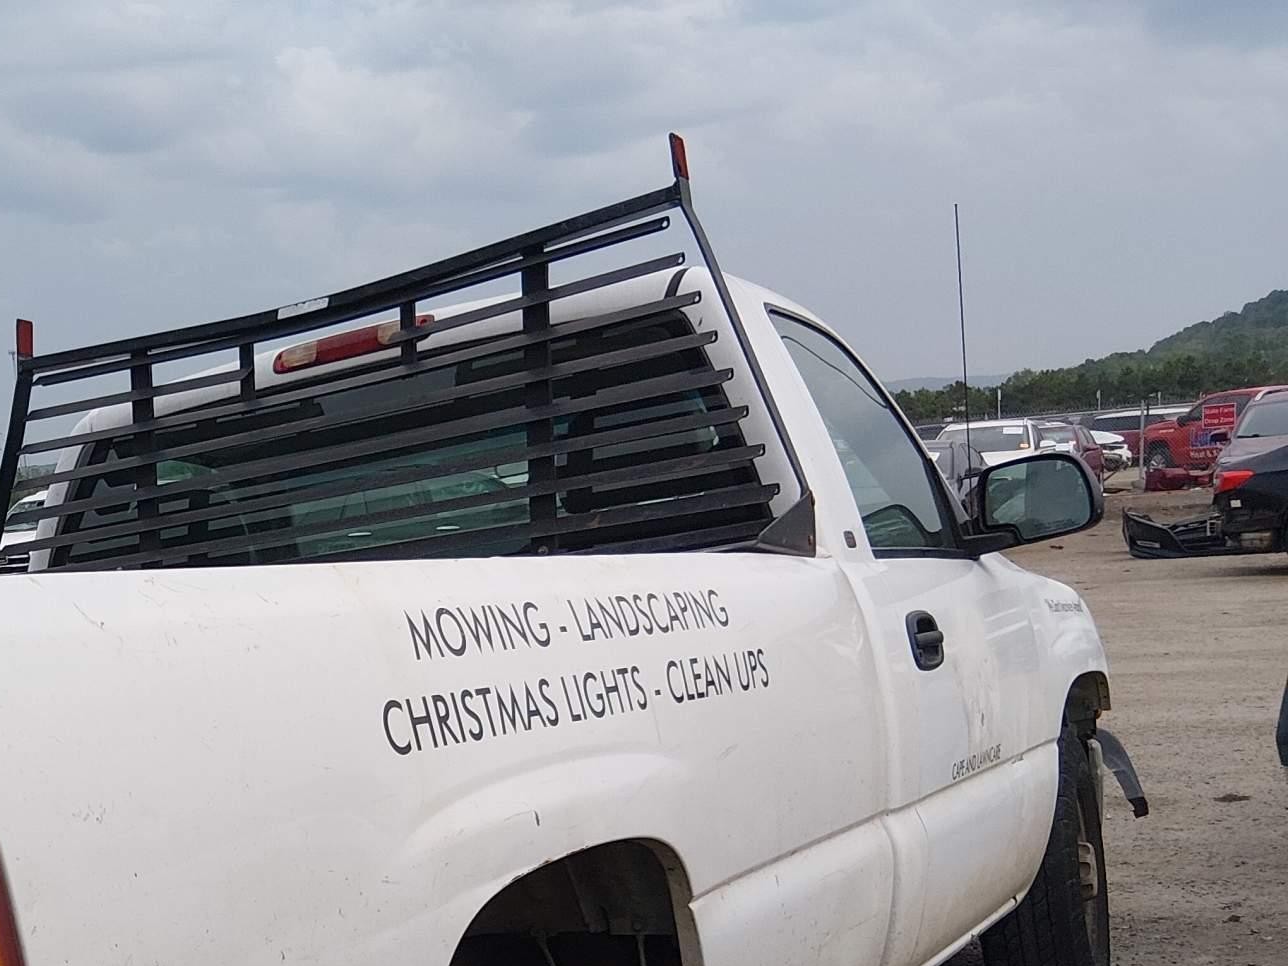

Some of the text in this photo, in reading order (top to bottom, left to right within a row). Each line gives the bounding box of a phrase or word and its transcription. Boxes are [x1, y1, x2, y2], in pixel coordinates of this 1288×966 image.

[404, 602, 551, 660] MOWING
[567, 589, 729, 641] LANDSCAPING
[383, 678, 559, 755] CHRISTMAS
[560, 666, 647, 722] LIGHTS
[666, 656, 733, 704] CLEAN
[734, 648, 769, 691] UPS
